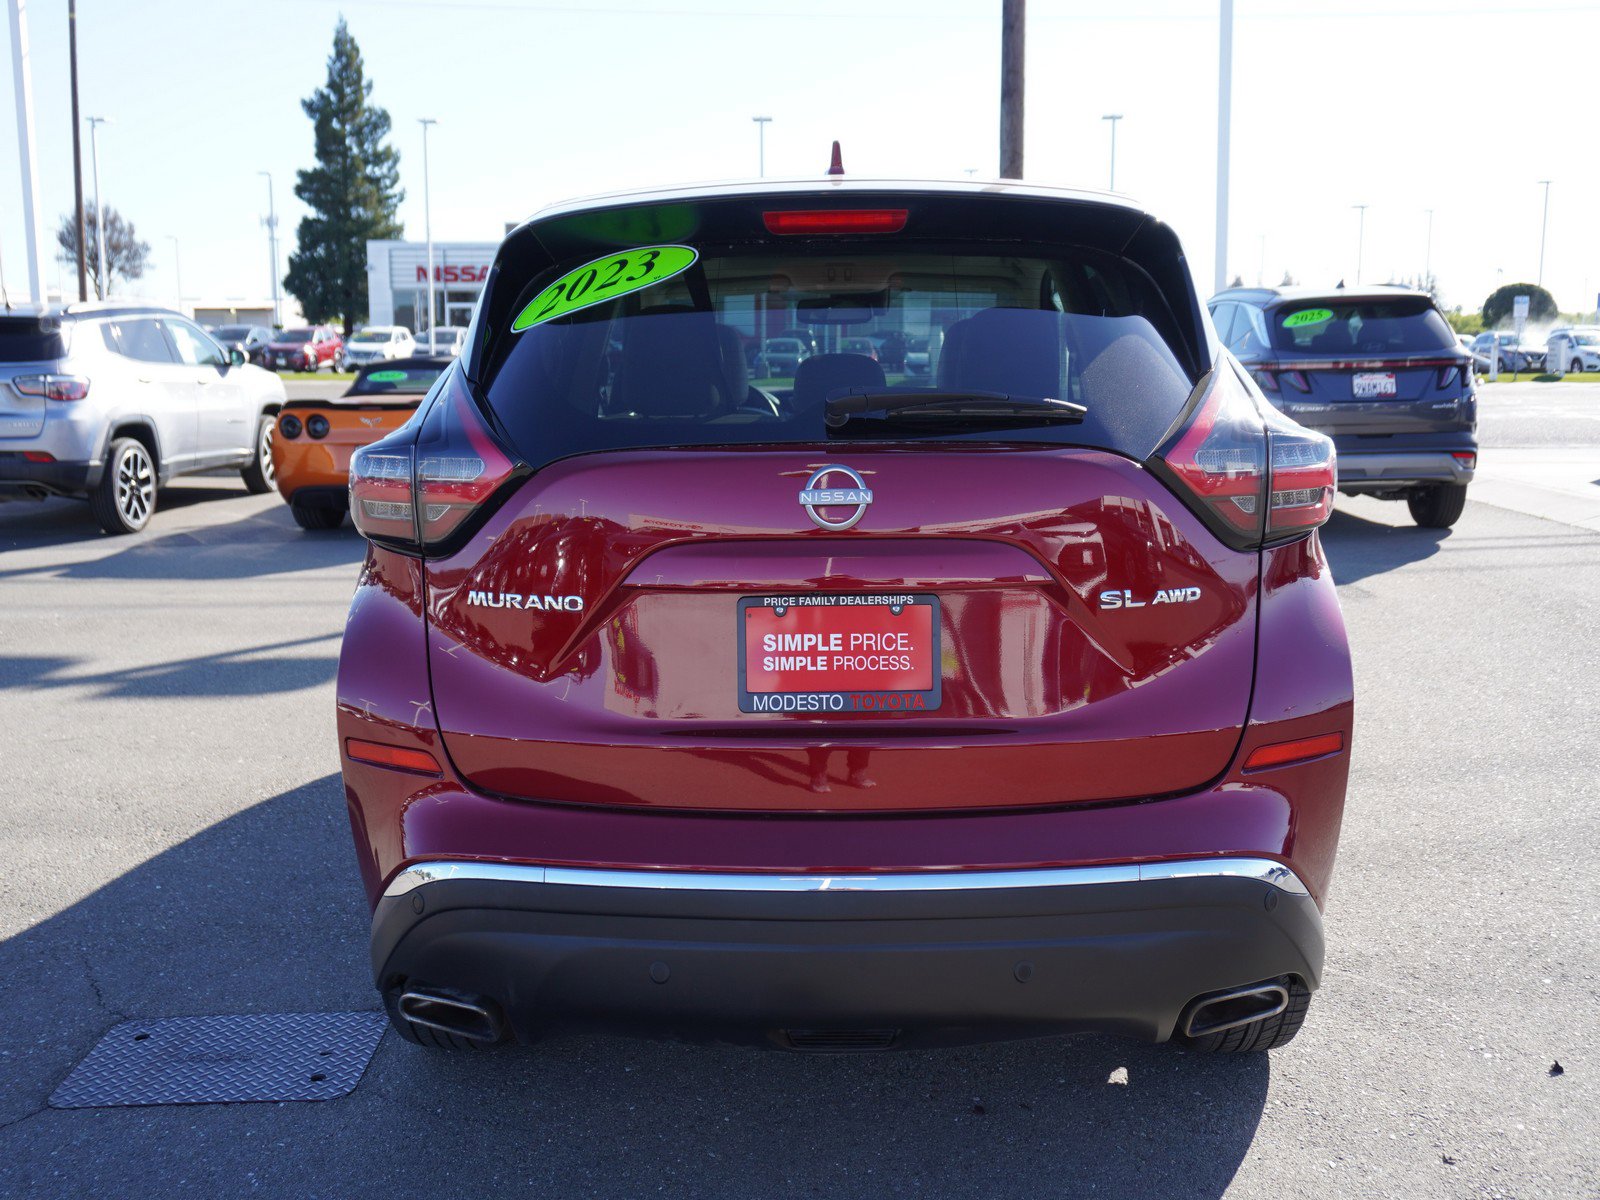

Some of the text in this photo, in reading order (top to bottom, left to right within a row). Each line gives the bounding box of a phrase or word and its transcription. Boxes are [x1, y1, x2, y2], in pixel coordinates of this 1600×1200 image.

[533, 250, 661, 321] 2023
[1294, 310, 1323, 325] 2025
[801, 491, 871, 502] NISSAN
[466, 590, 584, 611] MURANO
[764, 595, 914, 606] PRICE FAMILY DEALERSHIPS
[1100, 587, 1202, 609] SL AWD
[763, 633, 914, 652] SIMPLE PRICE.
[763, 655, 914, 671] SIMPLE PROCESS.
[753, 693, 926, 711] MODESTO TOYOTA
